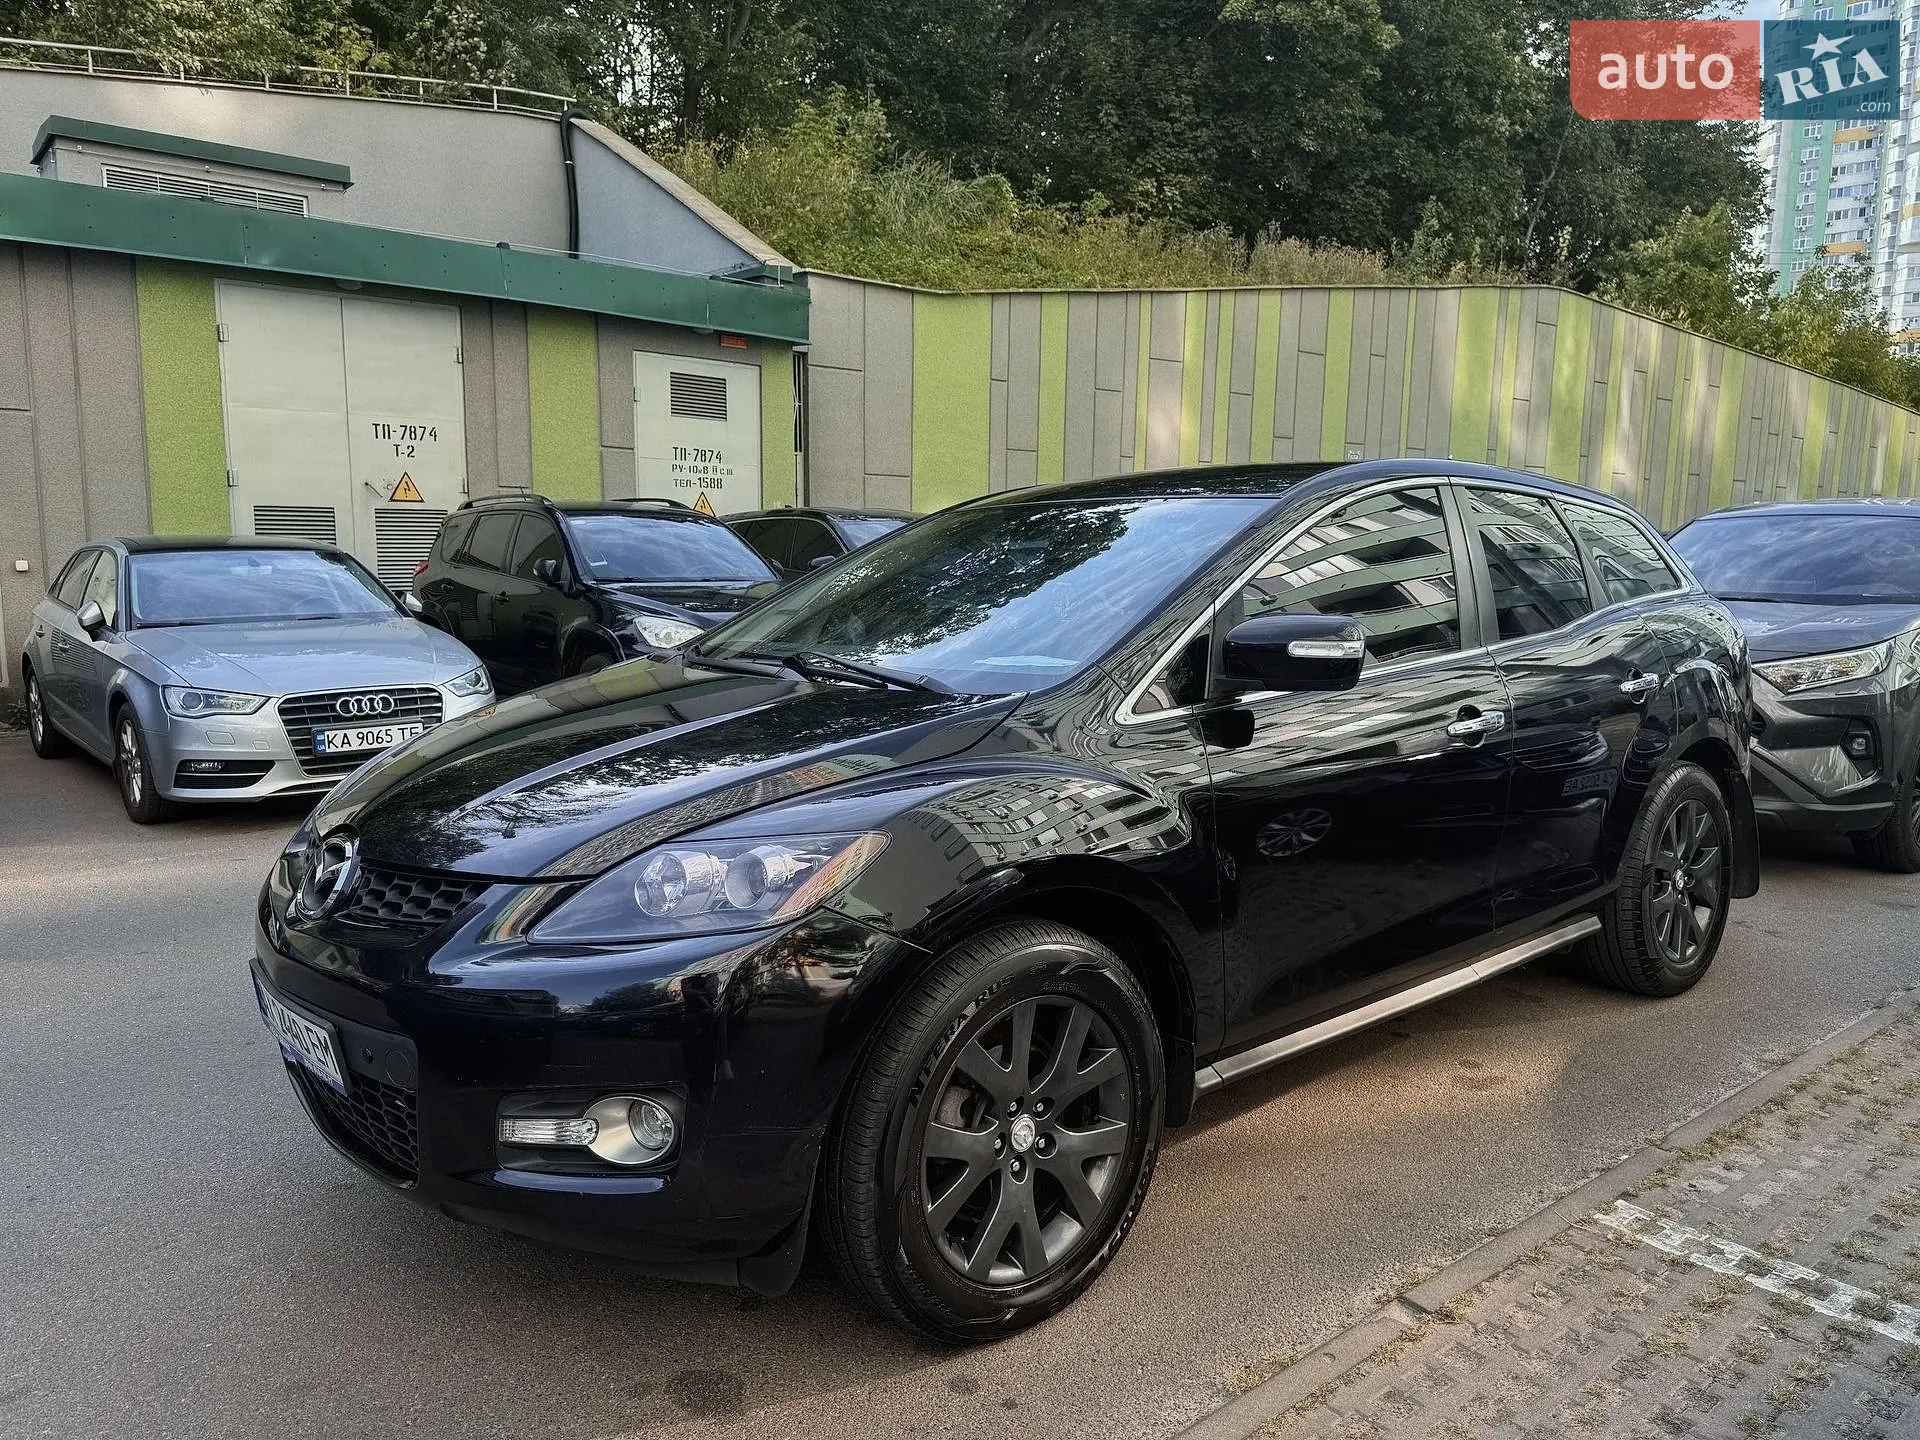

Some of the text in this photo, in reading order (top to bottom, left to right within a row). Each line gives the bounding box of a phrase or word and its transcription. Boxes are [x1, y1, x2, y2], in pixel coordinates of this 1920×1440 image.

[372, 423, 437, 442] ТП-7874
[393, 444, 415, 458] Т-2
[672, 446, 722, 464] ТП-7874
[326, 732, 352, 749] KA
[356, 729, 393, 746] 9065
[304, 1024, 339, 1075] EM
